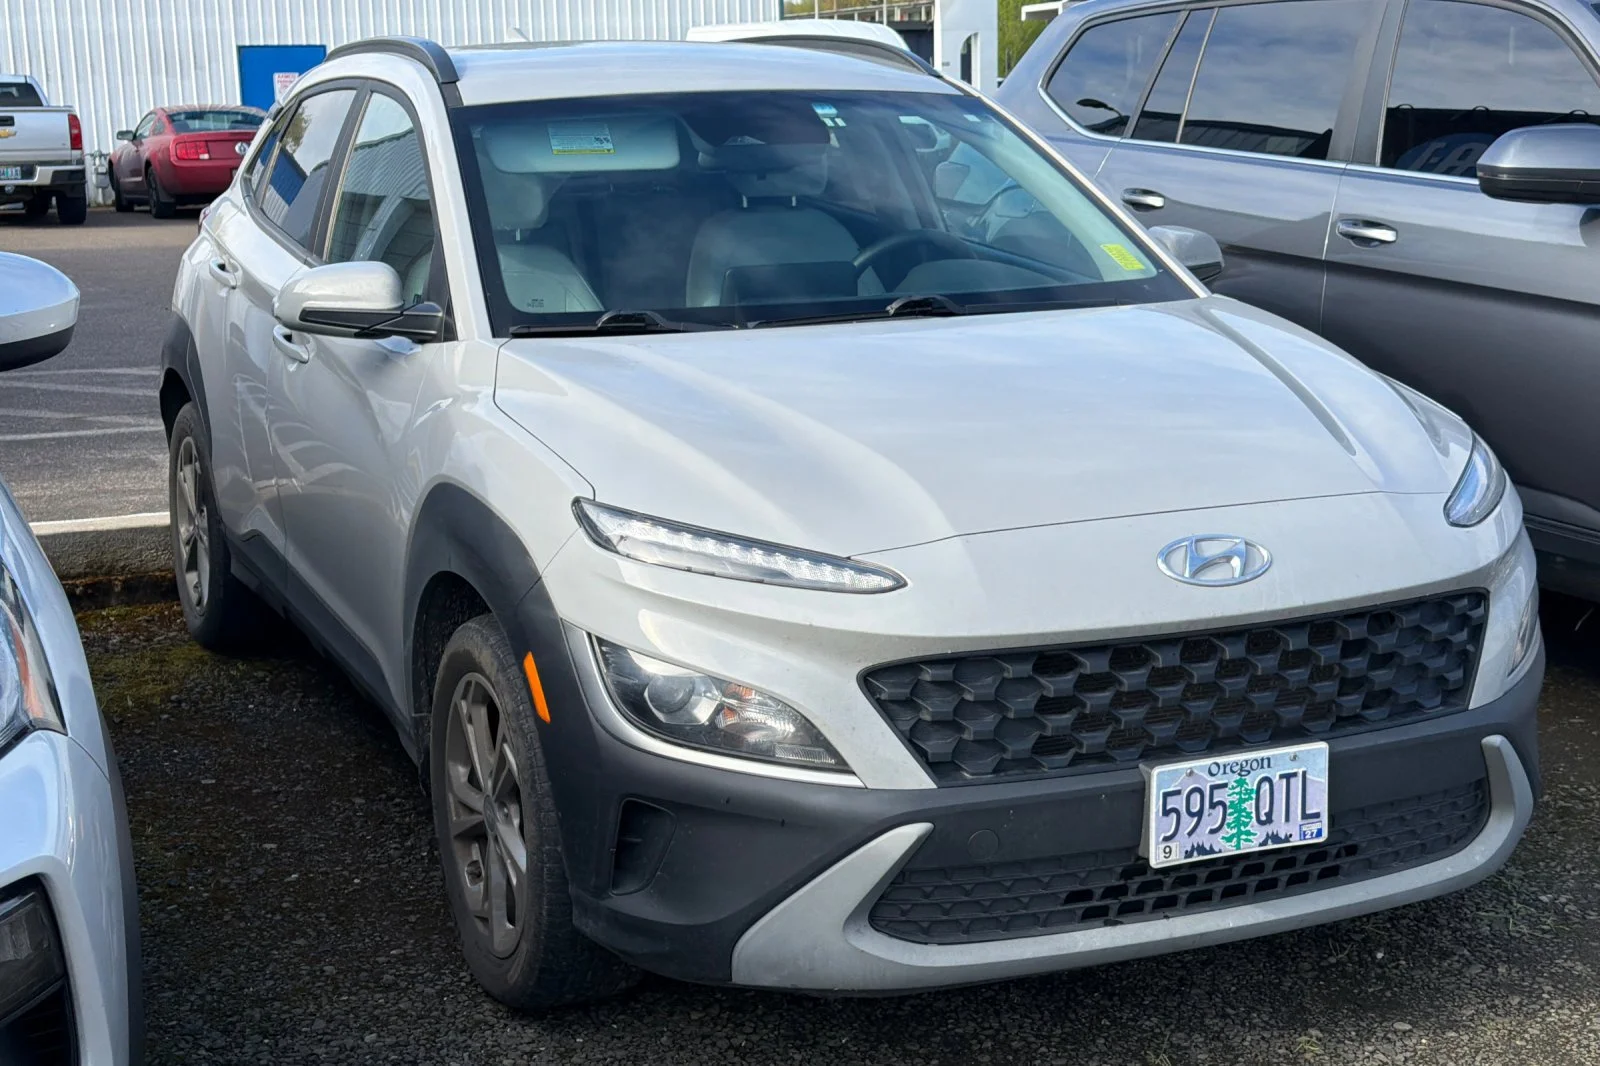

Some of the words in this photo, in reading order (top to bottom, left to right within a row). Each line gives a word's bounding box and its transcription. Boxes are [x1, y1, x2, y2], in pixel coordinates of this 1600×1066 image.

[1207, 756, 1272, 777] Oregon
[1161, 782, 1229, 842] 595
[1255, 769, 1321, 826] QTL
[1303, 828, 1318, 840] 27
[1163, 845, 1172, 859] 9
